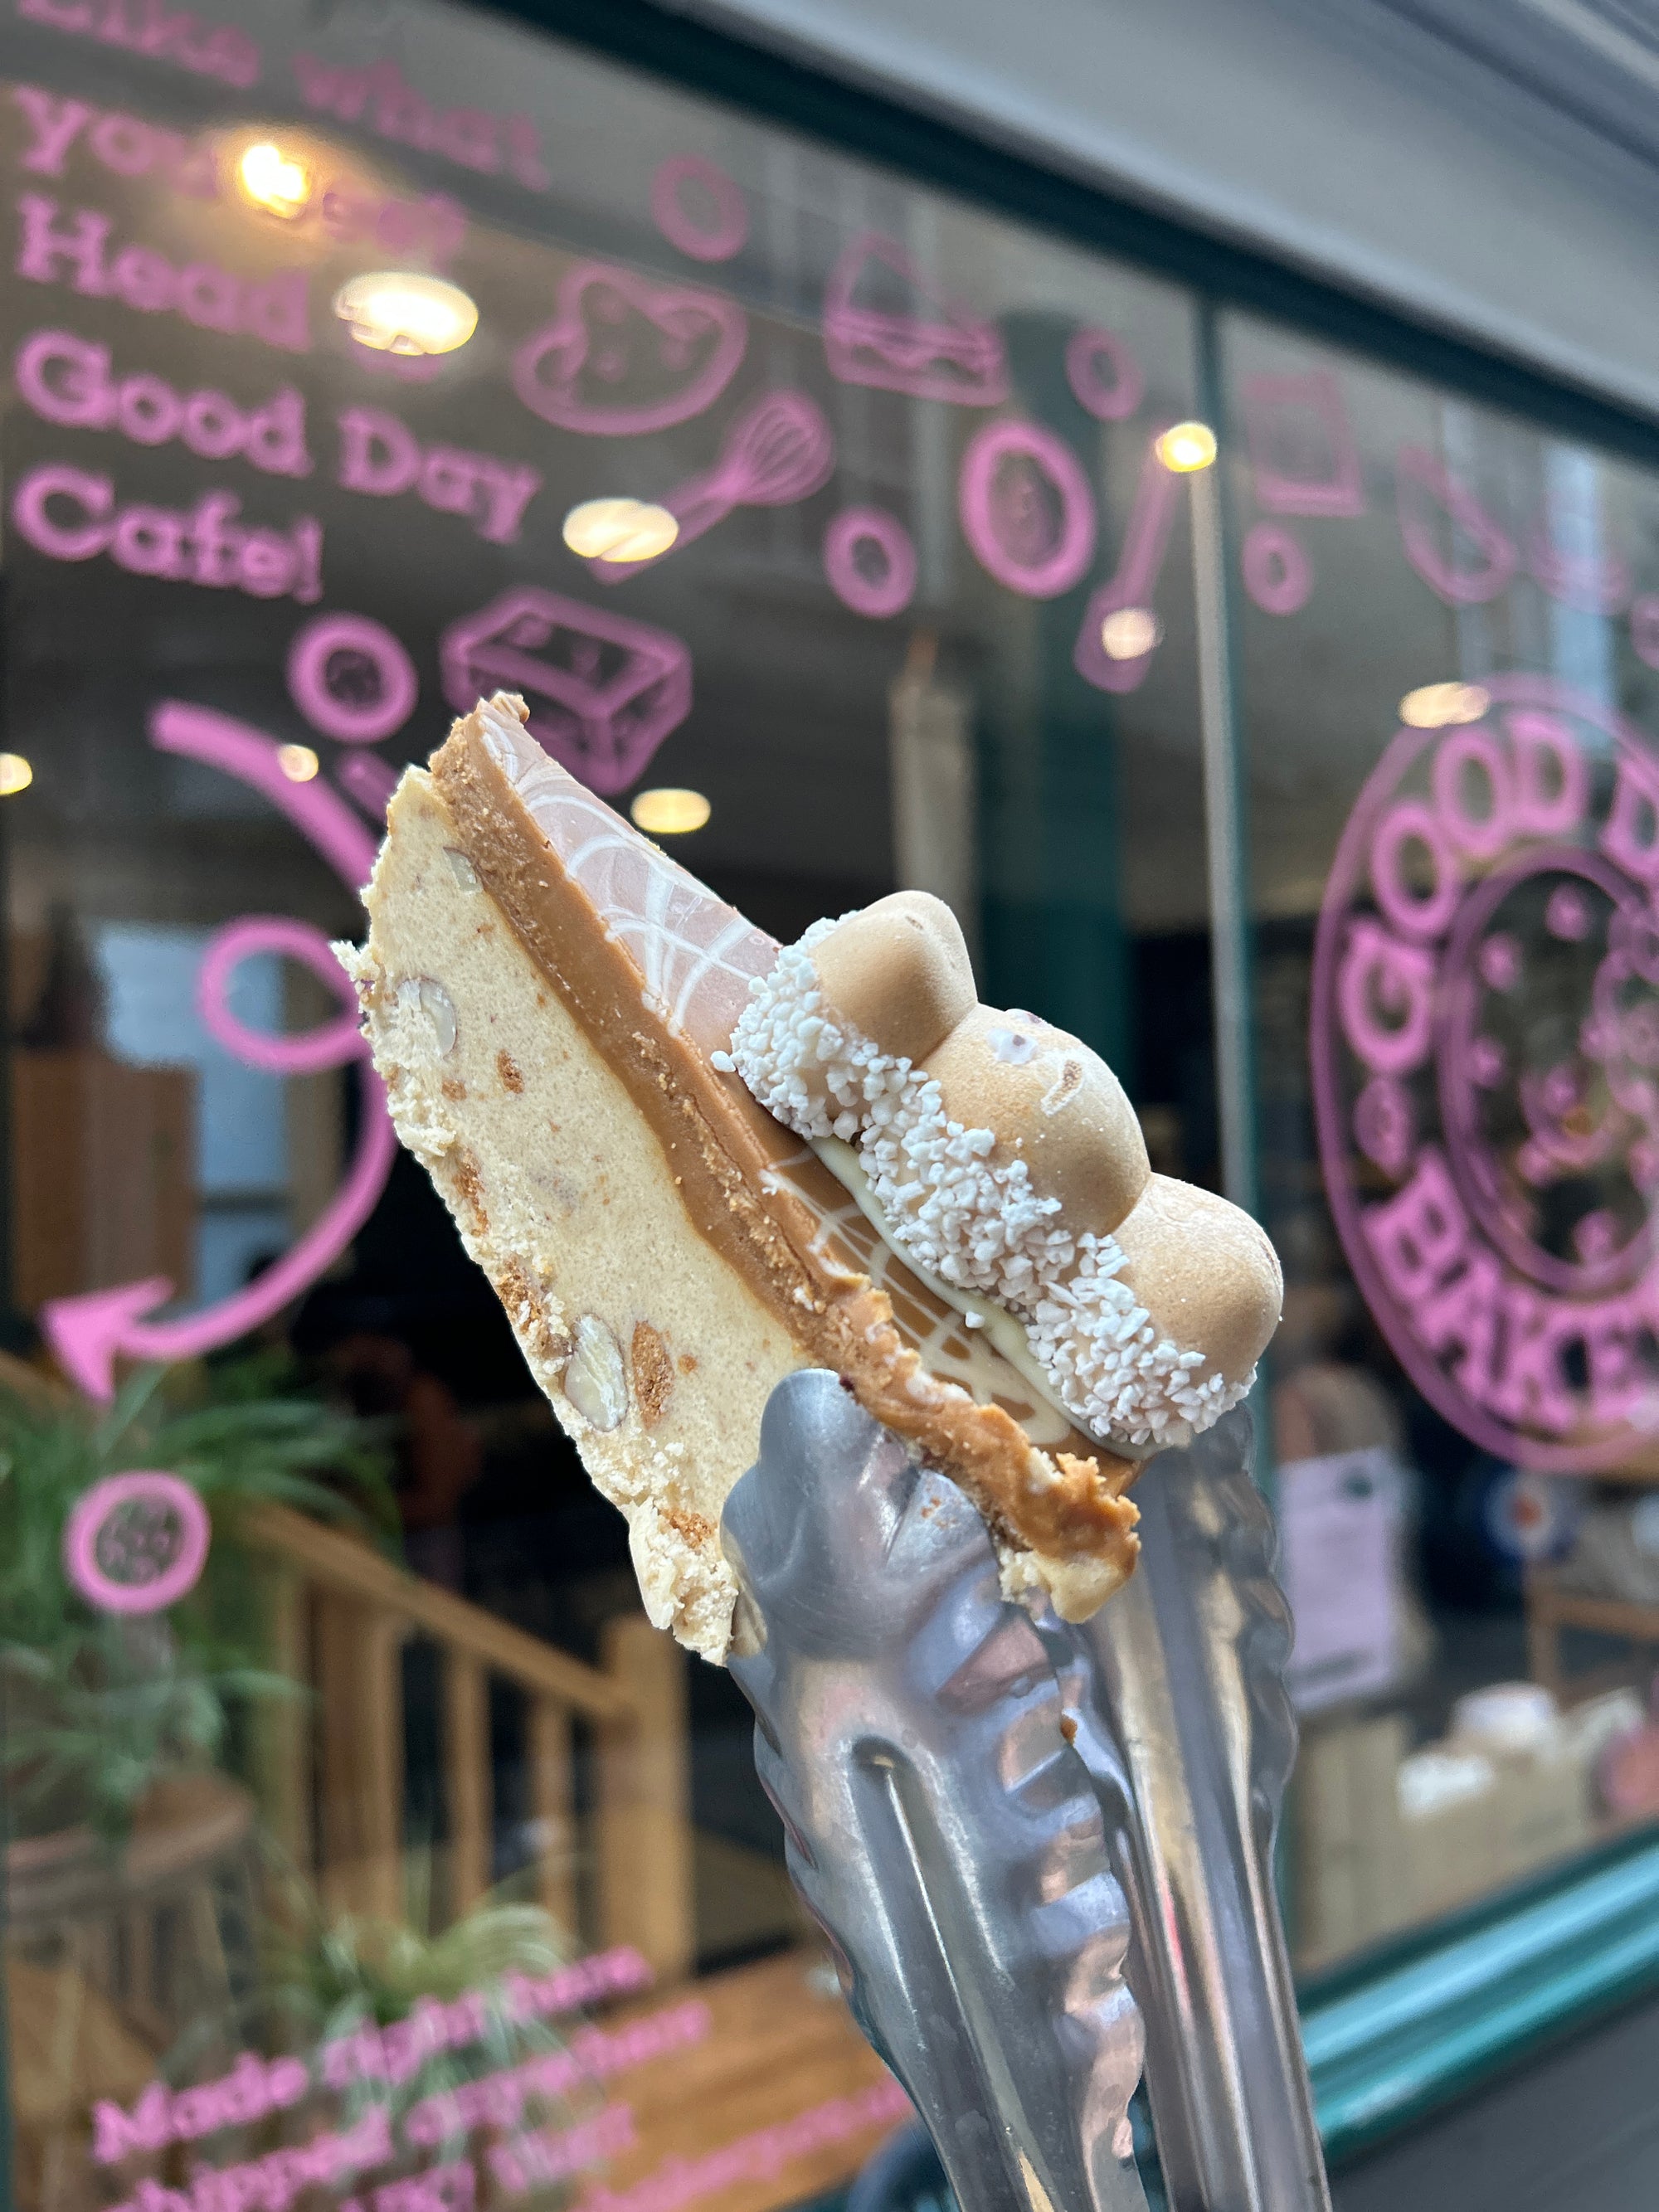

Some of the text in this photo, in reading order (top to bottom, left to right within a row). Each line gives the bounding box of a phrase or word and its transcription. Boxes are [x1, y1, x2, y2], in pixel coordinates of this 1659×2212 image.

[292, 53, 551, 194] what
[15, 191, 314, 355] Head
[14, 330, 543, 546] Good Day
[12, 461, 325, 605] Cafe!
[1337, 707, 1586, 1076] GOOD
[91, 2049, 309, 2163] Made
